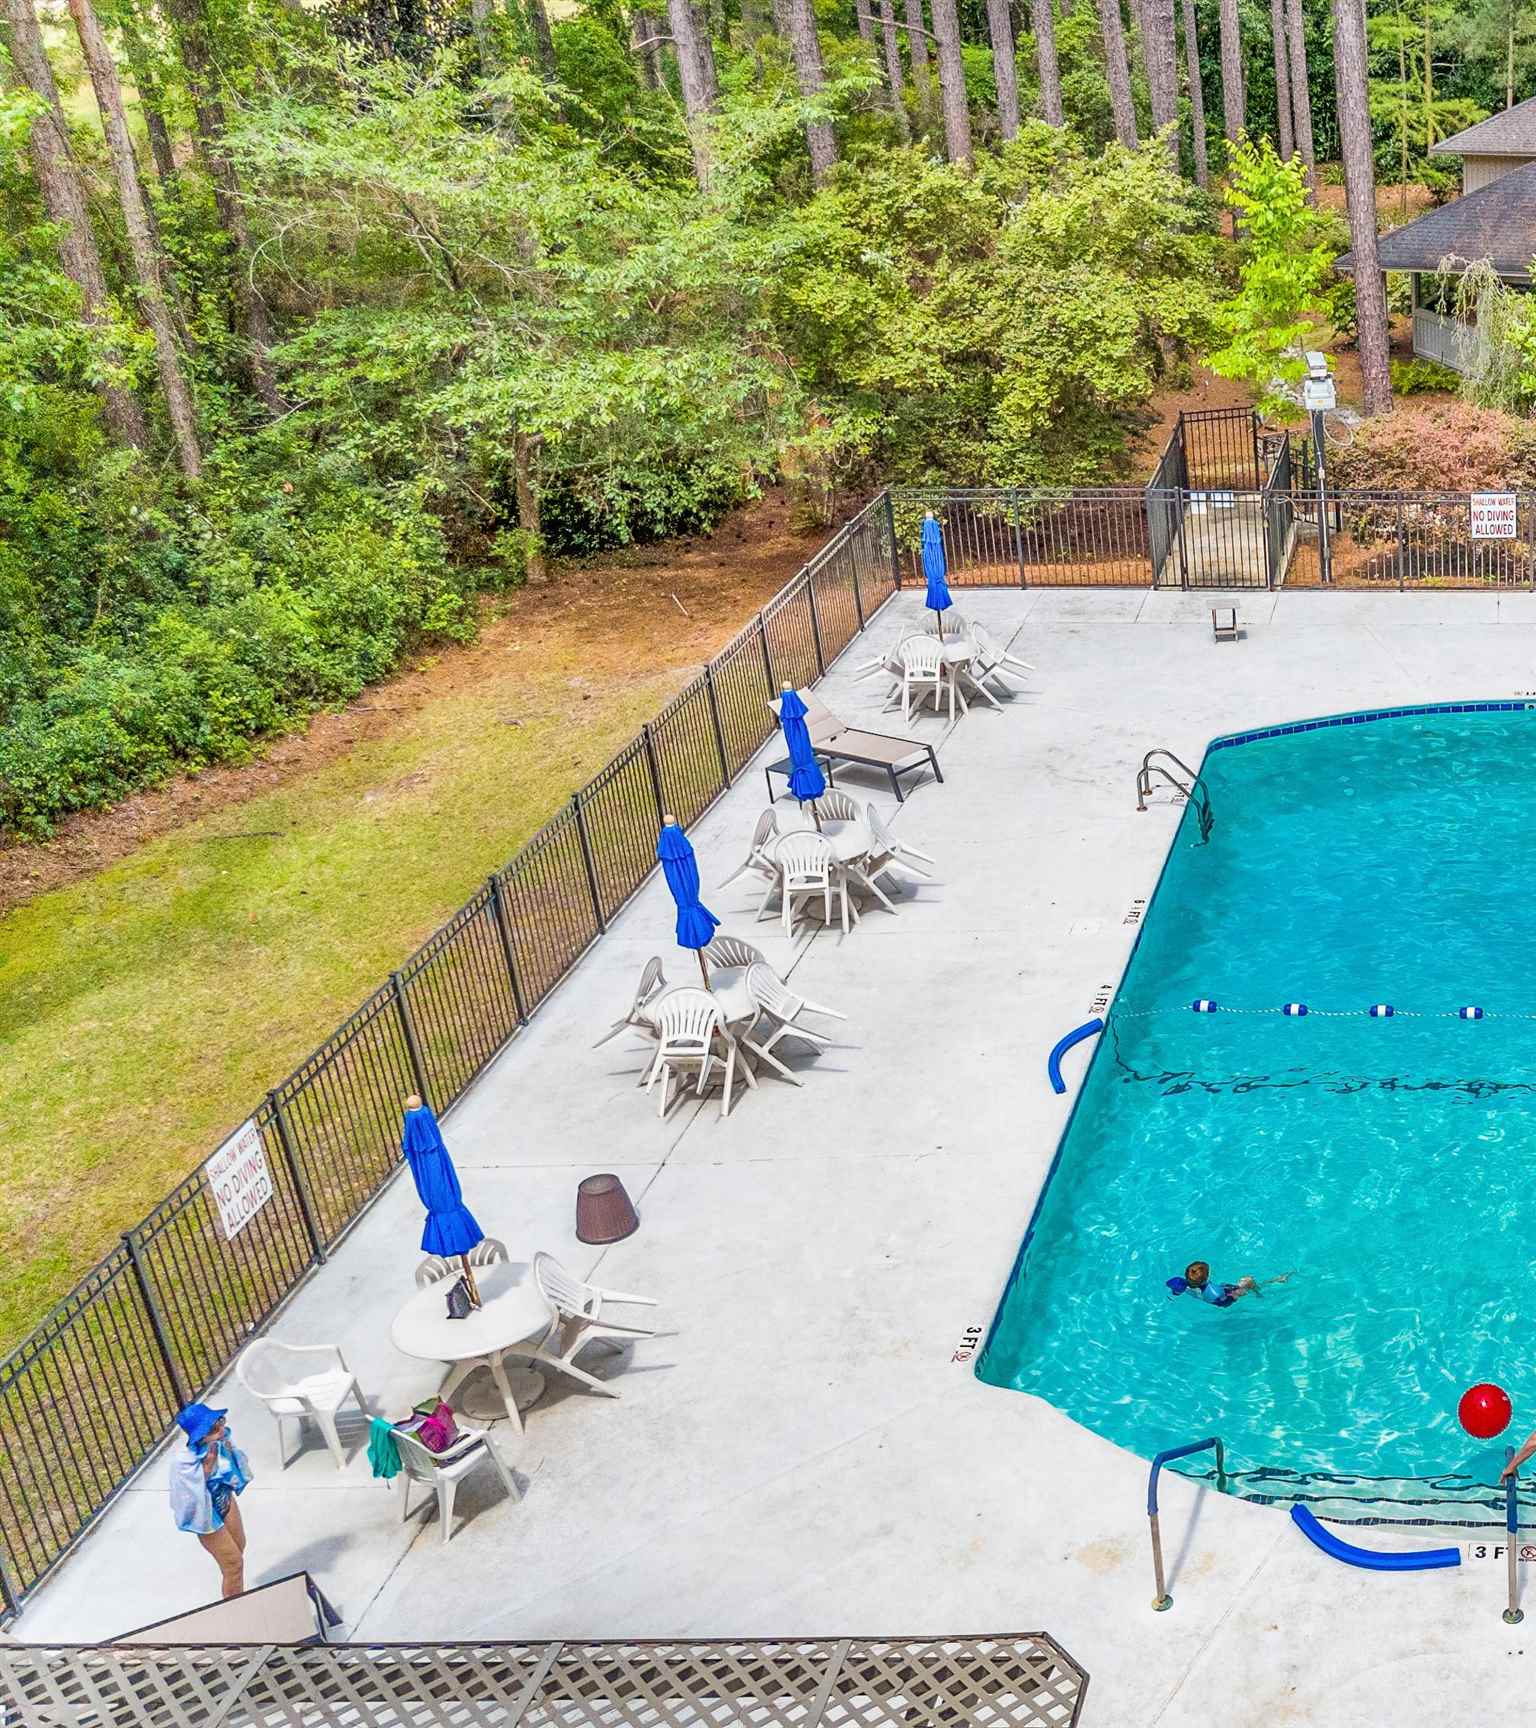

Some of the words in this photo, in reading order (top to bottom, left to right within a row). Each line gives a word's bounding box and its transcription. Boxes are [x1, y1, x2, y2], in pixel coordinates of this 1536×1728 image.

[1473, 510, 1484, 521] NO
[1487, 510, 1514, 521] DIVING
[1475, 524, 1513, 535] ALLOWED
[216, 1183, 232, 1209] NO
[232, 1150, 263, 1193] DIVING
[227, 1176, 268, 1232] ALLOWED
[960, 1337, 978, 1349] FT
[1475, 1545, 1487, 1558] 3
